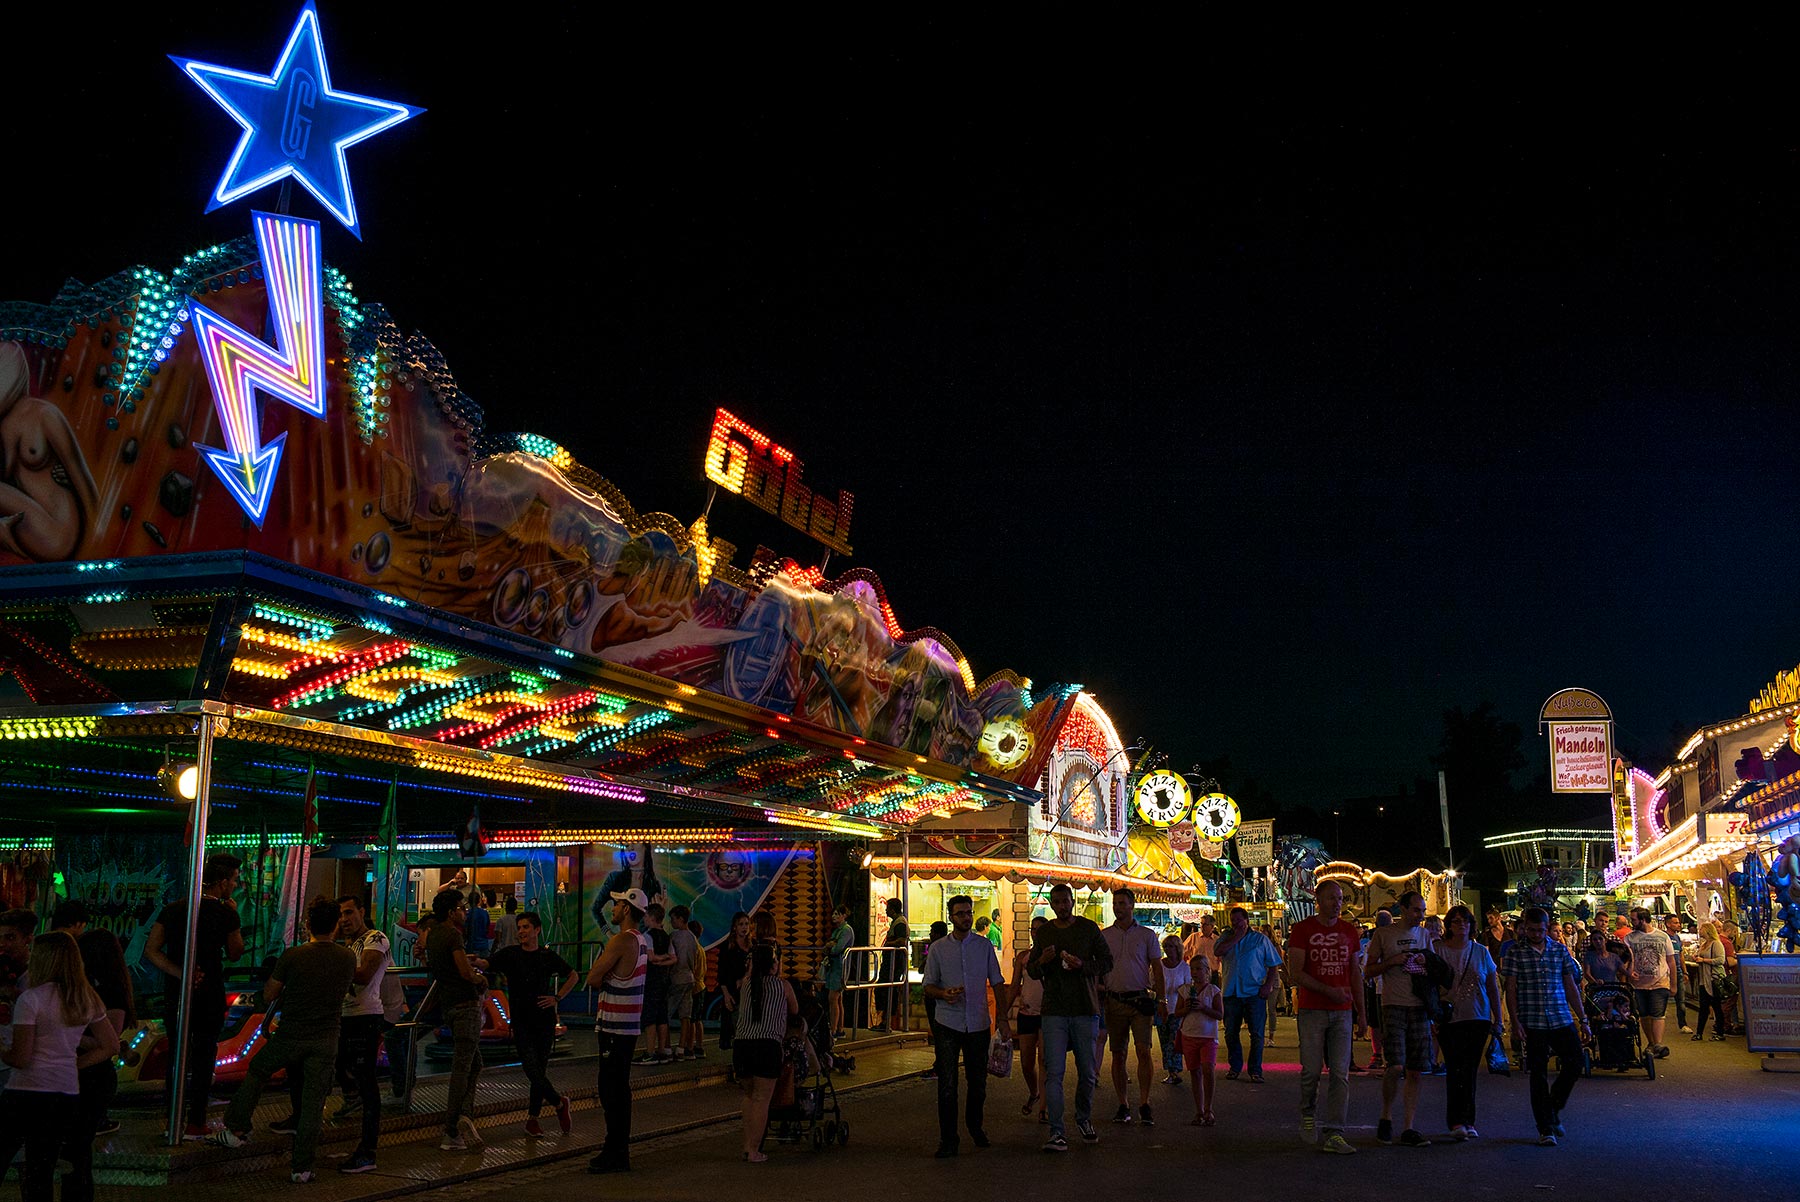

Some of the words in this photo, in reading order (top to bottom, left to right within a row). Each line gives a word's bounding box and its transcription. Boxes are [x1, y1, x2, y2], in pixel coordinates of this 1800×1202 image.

[1556, 725, 1574, 735] Frisch
[1575, 725, 1604, 735] gebrannte
[1556, 737, 1605, 753] Mandeln
[1558, 772, 1570, 780] Wo?
[1141, 776, 1178, 797] PIZZA
[1146, 800, 1183, 821] KRUG
[1197, 798, 1229, 816] PIZZA
[1202, 819, 1234, 836] KRUG
[1236, 834, 1272, 847] Früchte
[1309, 932, 1339, 946] QS
[1310, 945, 1349, 962] CORE
